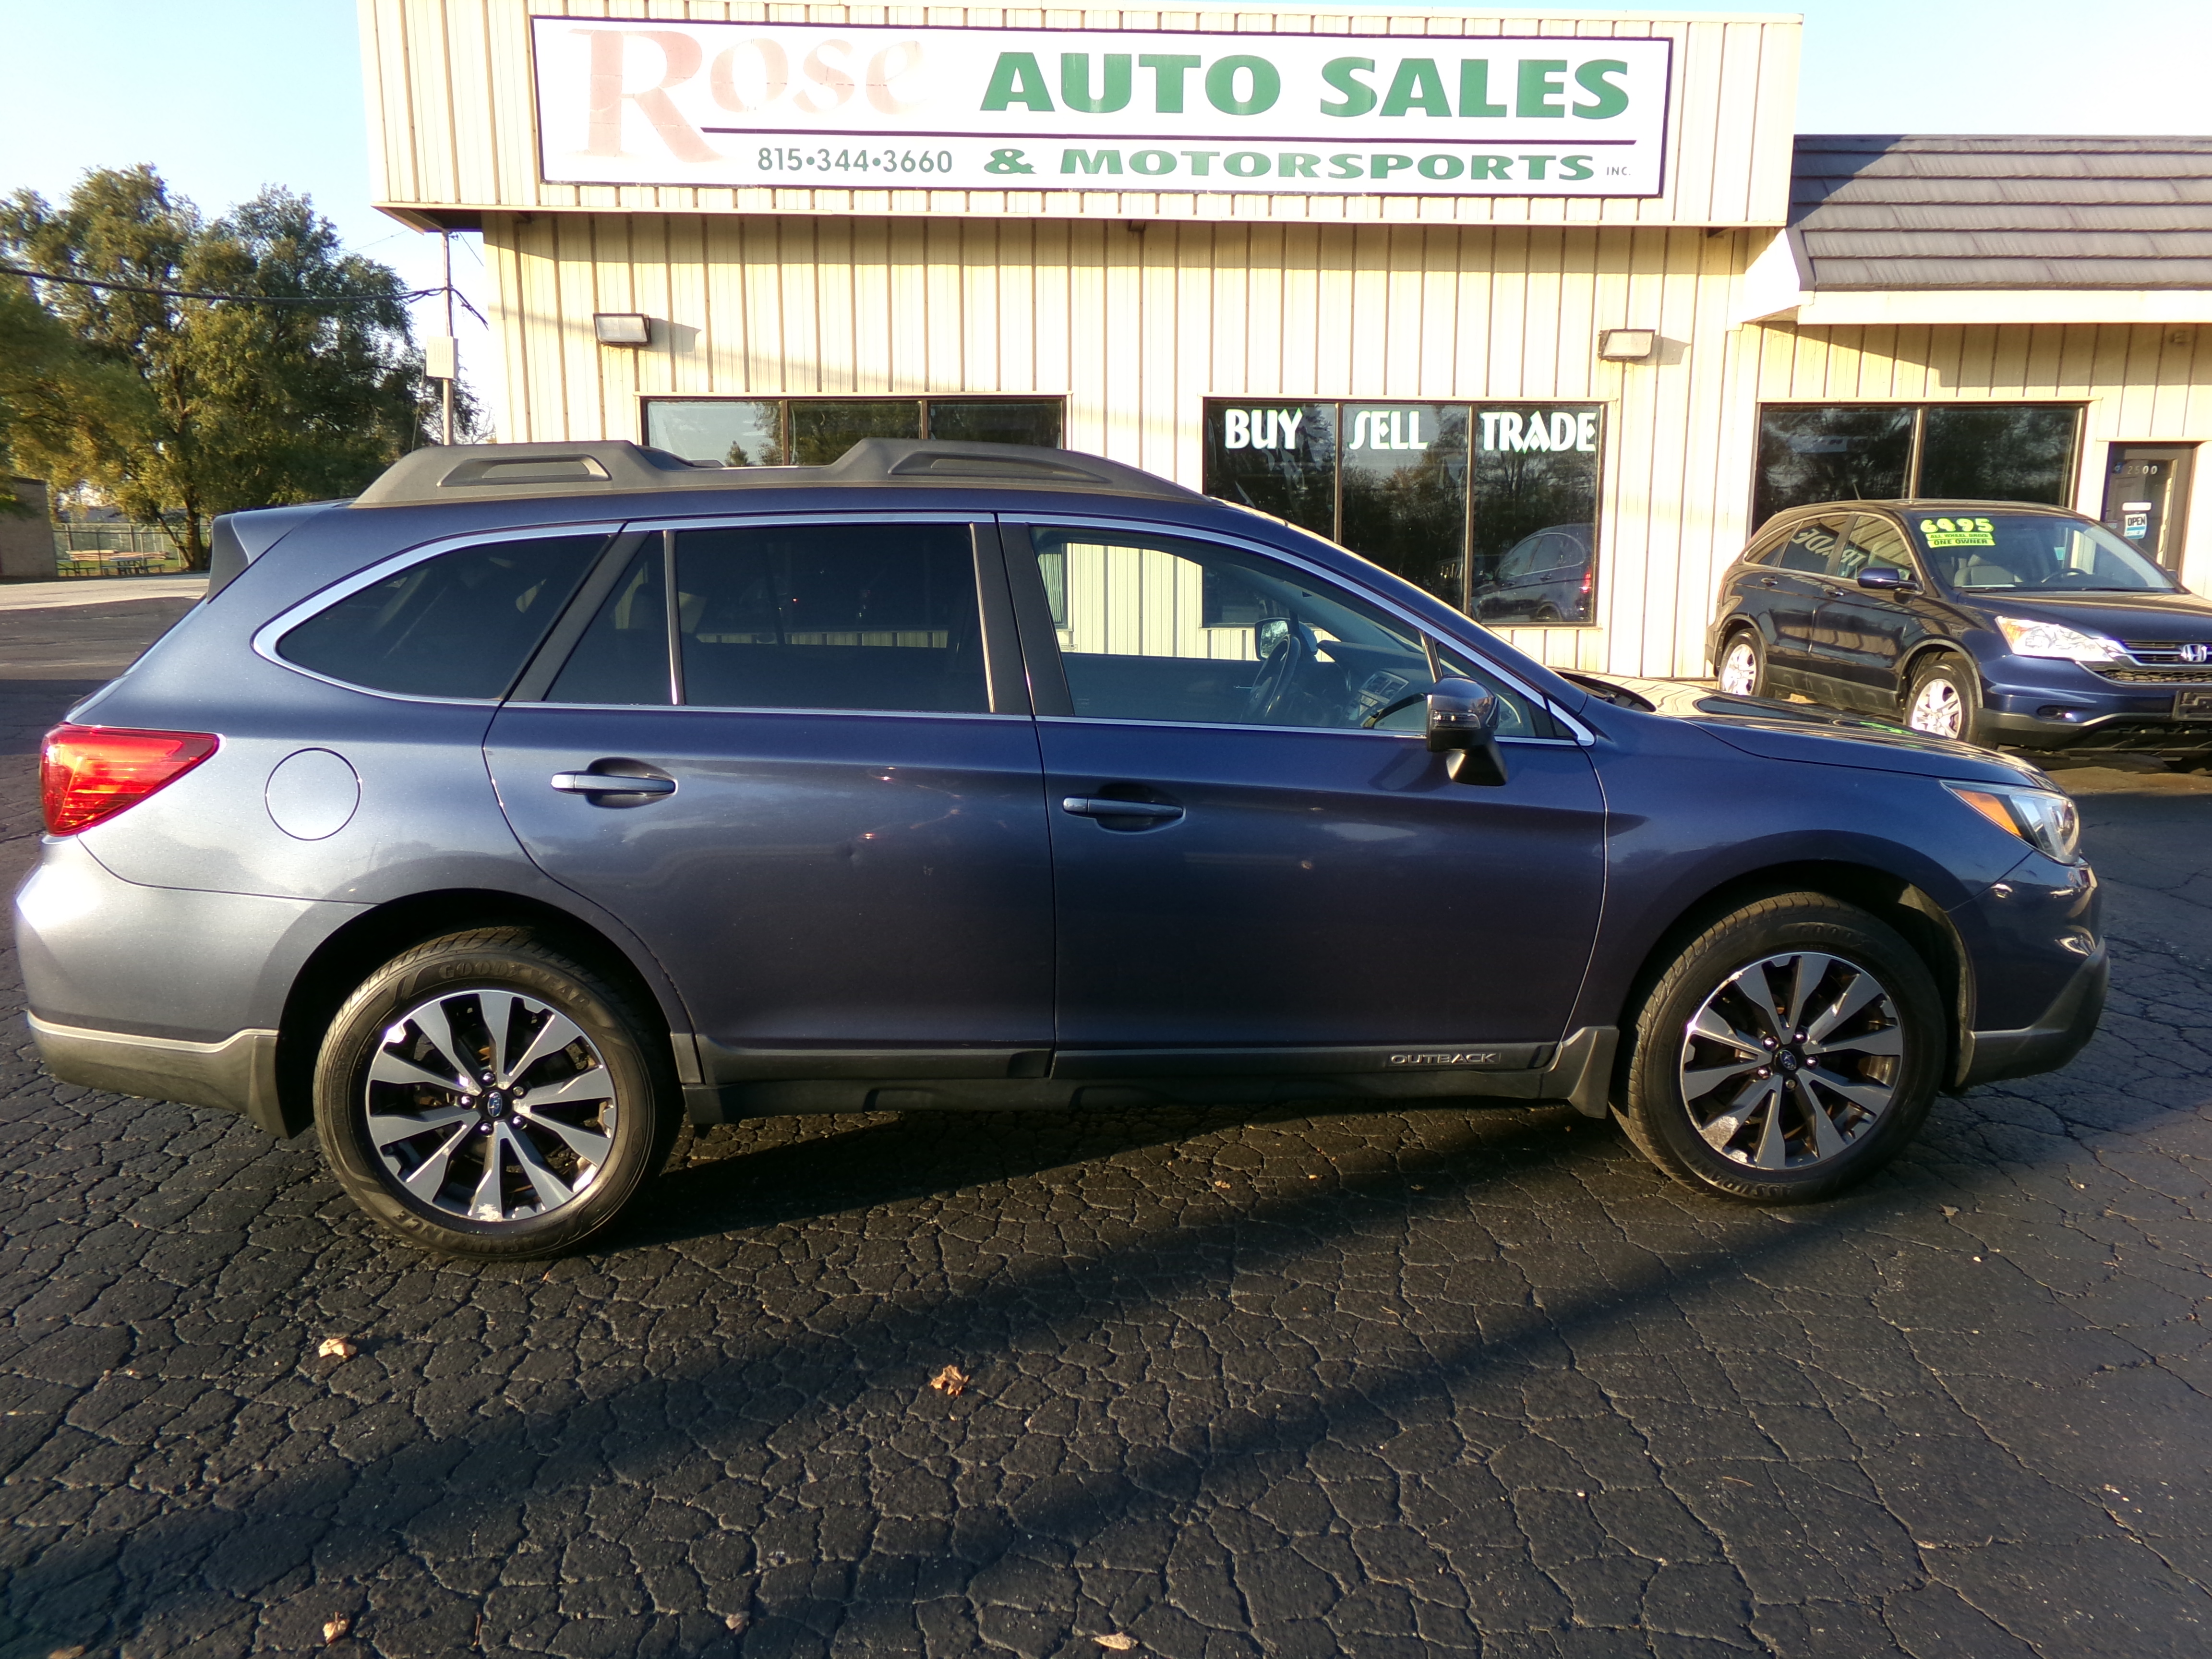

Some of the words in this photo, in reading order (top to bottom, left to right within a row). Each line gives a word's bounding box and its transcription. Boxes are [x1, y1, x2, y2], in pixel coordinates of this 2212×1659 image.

[568, 29, 926, 163] Rose
[979, 51, 1281, 116] AUTO
[1320, 56, 1630, 120] SALES
[984, 148, 1037, 175] &
[1060, 149, 1594, 181] MOTORSPORTS
[1606, 166, 1631, 176] INC.
[1225, 408, 1303, 450] BUY
[1348, 410, 1429, 450] SELL
[1479, 411, 1598, 454] TRADE
[2127, 465, 2158, 475] 2500
[2128, 516, 2146, 527] OPEN
[1391, 1053, 1496, 1064] OUTBACK
